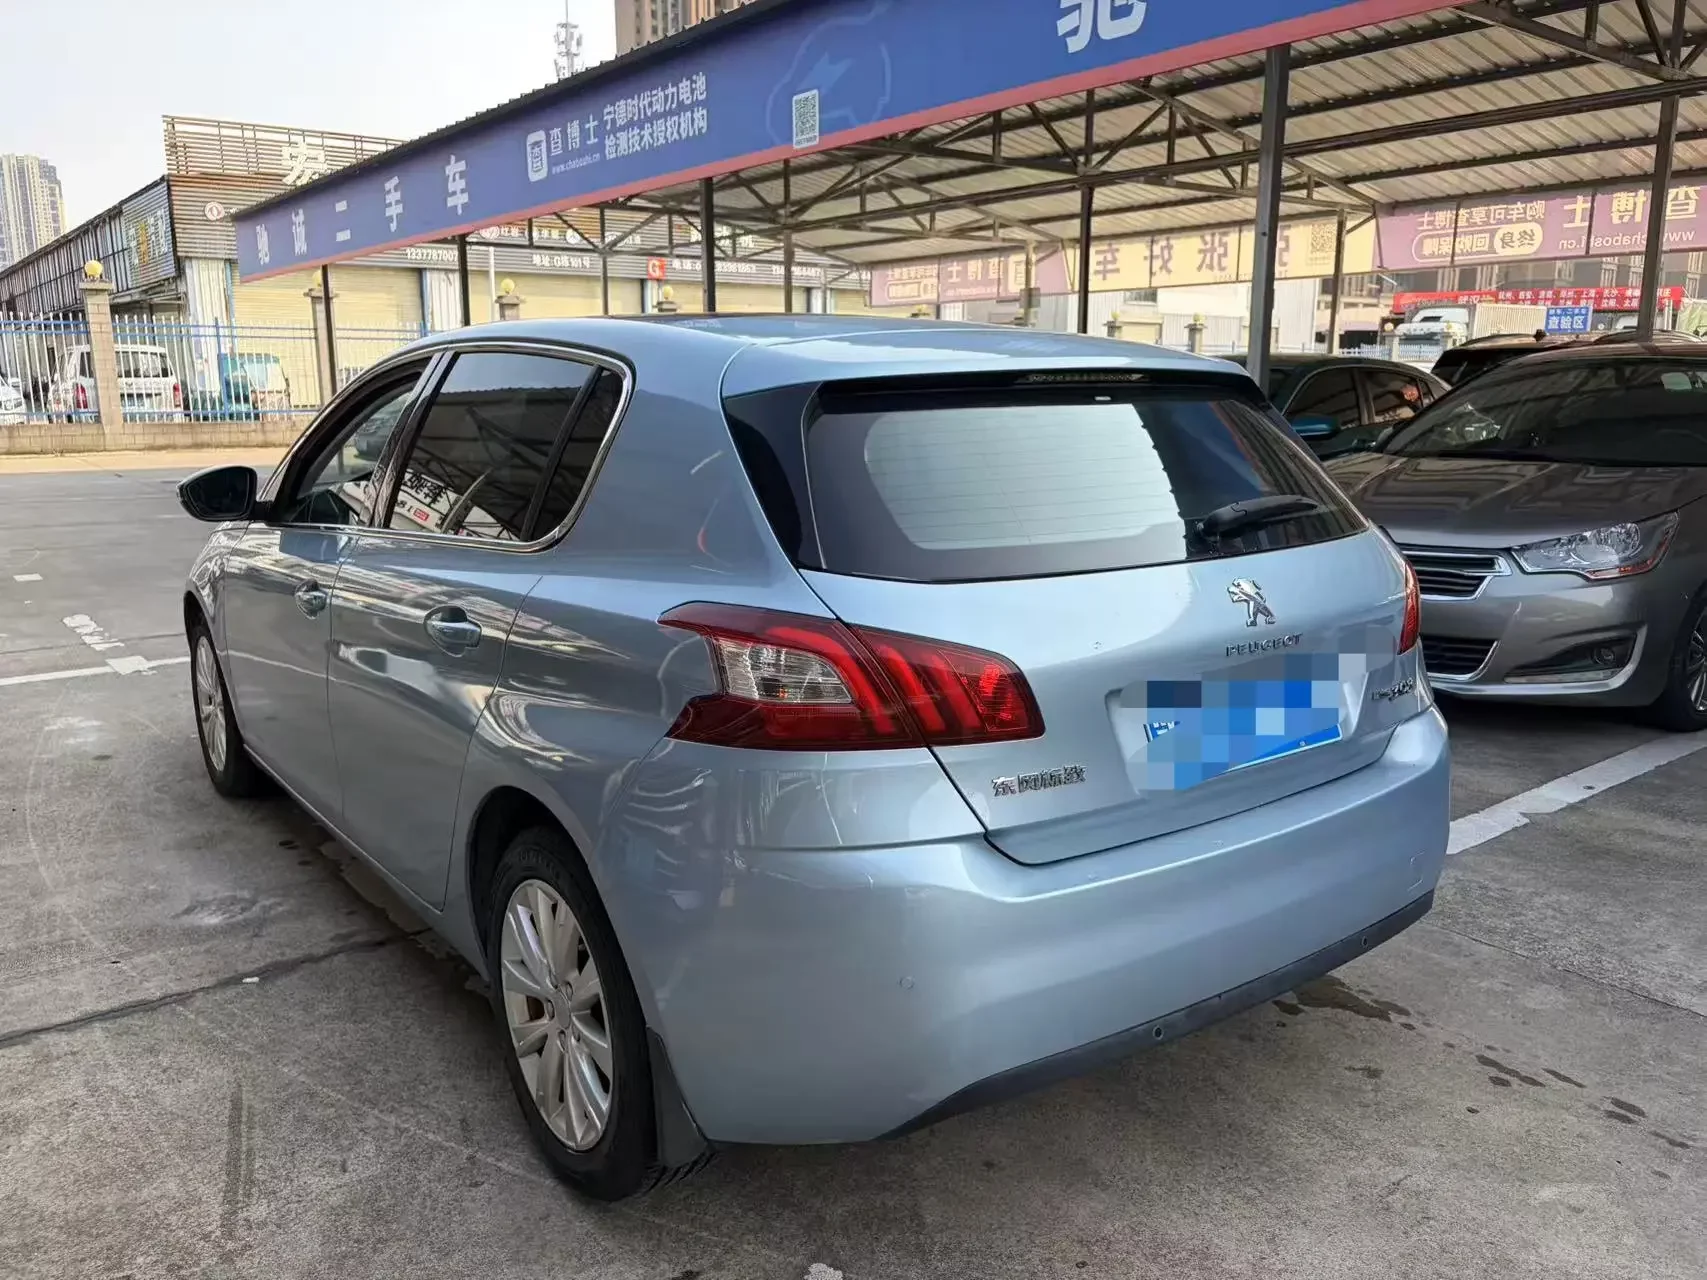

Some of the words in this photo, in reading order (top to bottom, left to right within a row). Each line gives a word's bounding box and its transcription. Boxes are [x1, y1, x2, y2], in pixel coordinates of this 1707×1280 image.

[603, 71, 707, 131] 宁德时代动力电池
[550, 113, 598, 157] 查博士
[604, 106, 708, 161] 检测技术授权机构
[551, 152, 600, 176] www.chaboshi.cn
[1226, 634, 1303, 657] PEUGEOT
[990, 764, 1087, 797] 东风标致
